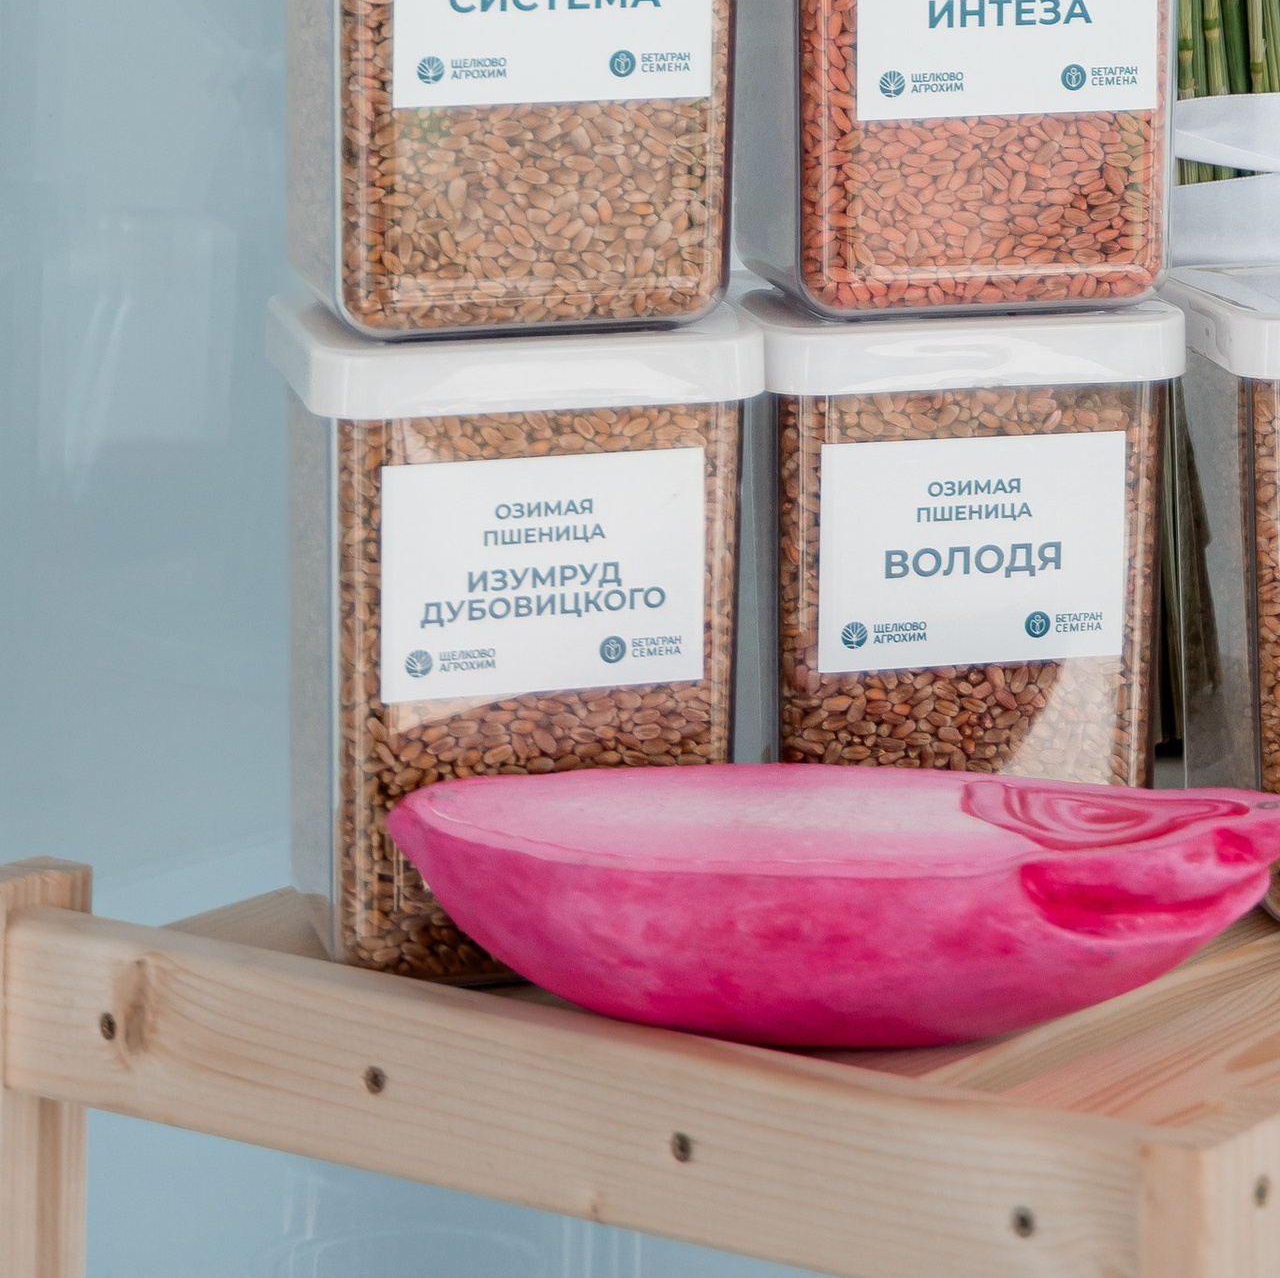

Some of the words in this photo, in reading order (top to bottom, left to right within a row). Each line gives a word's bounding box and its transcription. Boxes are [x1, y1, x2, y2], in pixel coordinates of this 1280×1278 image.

[450, 57, 507, 70] ЩЕЛКОВО
[641, 52, 691, 63] БЕТАГРАН
[450, 67, 507, 80] АГРОХИМ
[641, 62, 691, 73] СЕМЕНА
[1091, 65, 1138, 77] БЕТАГРАН
[911, 71, 964, 84] ЩЕЛКОВО
[1091, 75, 1138, 86] СЕМЕНА
[911, 81, 964, 94] АГРОХИМ
[927, 477, 1022, 498] ОЗИМАЯ
[494, 498, 594, 520] ОЗИМАЯ
[916, 502, 1033, 523] ПШЕНИЦА
[483, 523, 606, 547] ПШЕНИЦА
[884, 541, 1063, 579] ВОЛОДЯ
[467, 561, 622, 593] ИЗУМРУД
[420, 586, 667, 629] ДУБОВИЦКОГО
[1055, 611, 1103, 623] БЕТАГРАН
[873, 621, 927, 634] ЩЕЛКОВО
[1055, 620, 1103, 634] СЕМЕНА
[631, 635, 682, 648] БЕТАГРАН
[873, 631, 927, 645] АГРОХИМ
[438, 647, 496, 662] ЩЕЛКОВО
[631, 645, 682, 658] СЕМЕНА
[438, 658, 496, 673] АГРОХИМ
